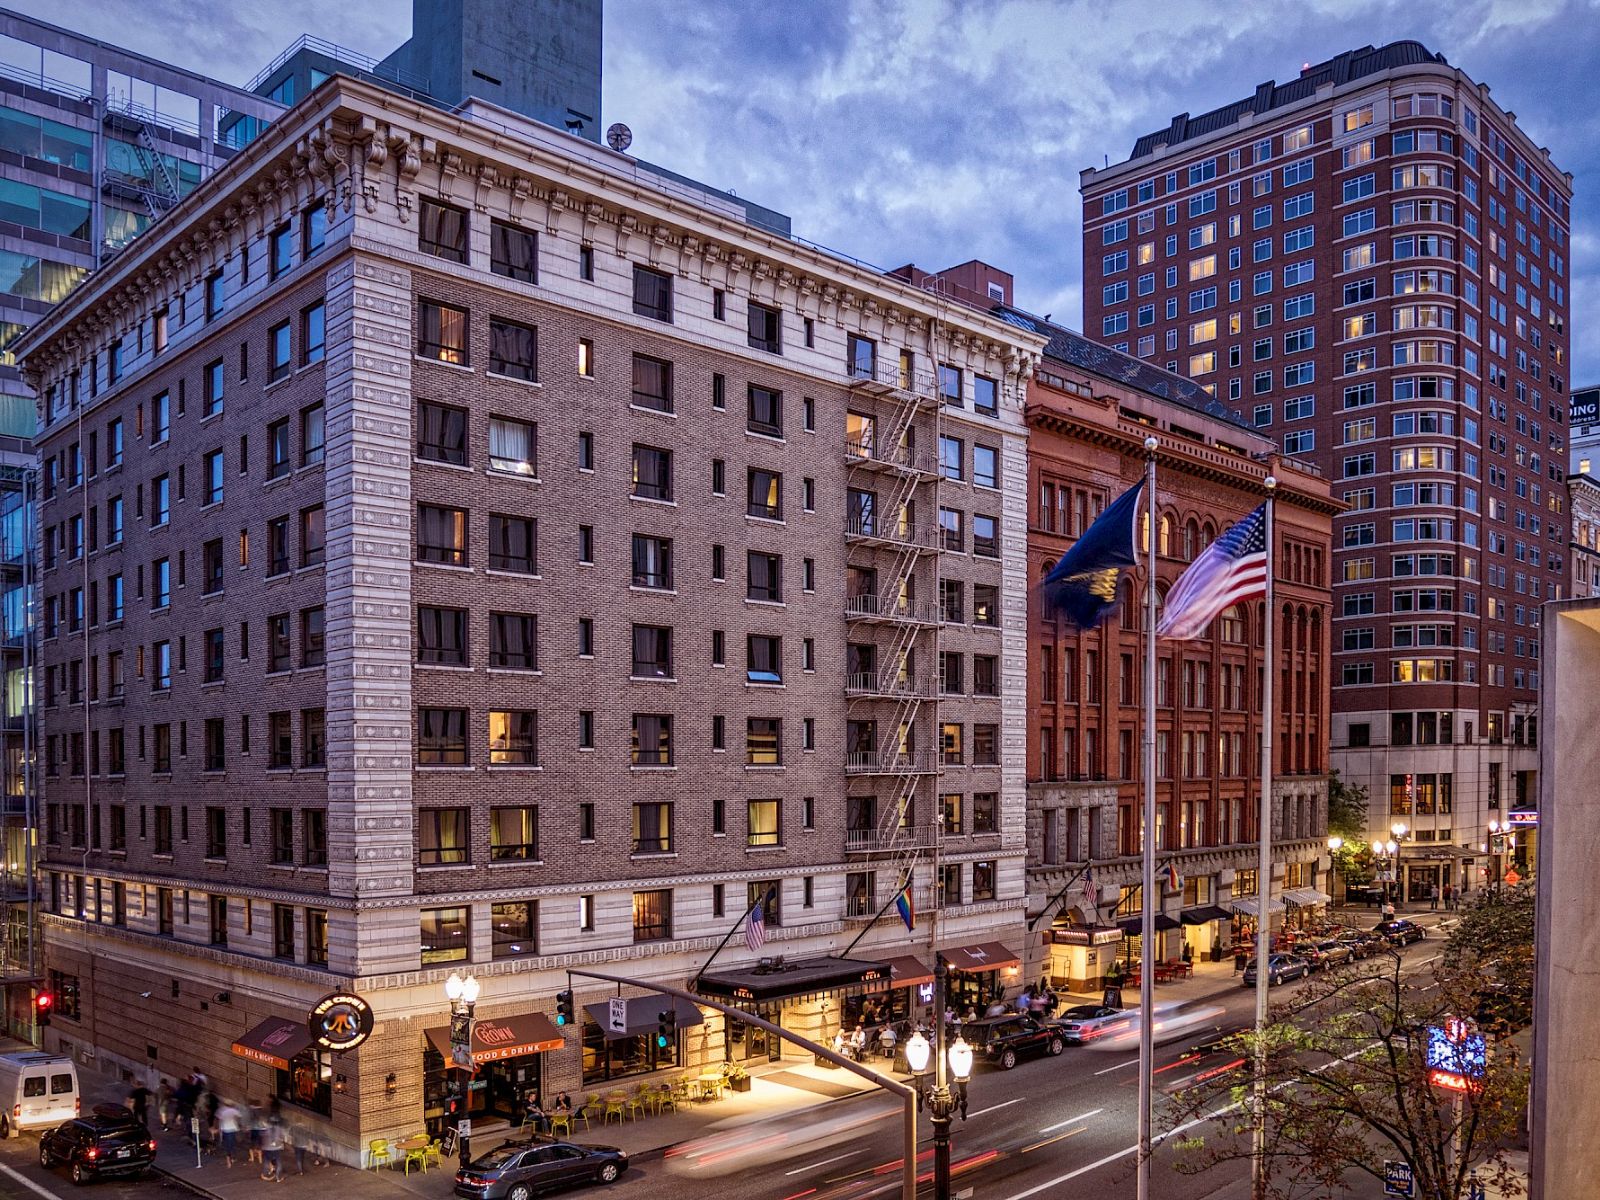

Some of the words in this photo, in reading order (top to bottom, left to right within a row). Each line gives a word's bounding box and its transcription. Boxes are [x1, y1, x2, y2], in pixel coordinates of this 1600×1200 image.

[861, 973, 880, 981] LUCIA
[733, 990, 754, 999] LUCIA
[612, 1000, 624, 1010] ONE
[611, 1009, 624, 1019] WAY
[481, 1022, 496, 1030] THE
[475, 1026, 516, 1046] CROWN
[472, 1052, 498, 1061] FOOD
[511, 1044, 540, 1055] DRINK
[1387, 1167, 1412, 1181] PARK
